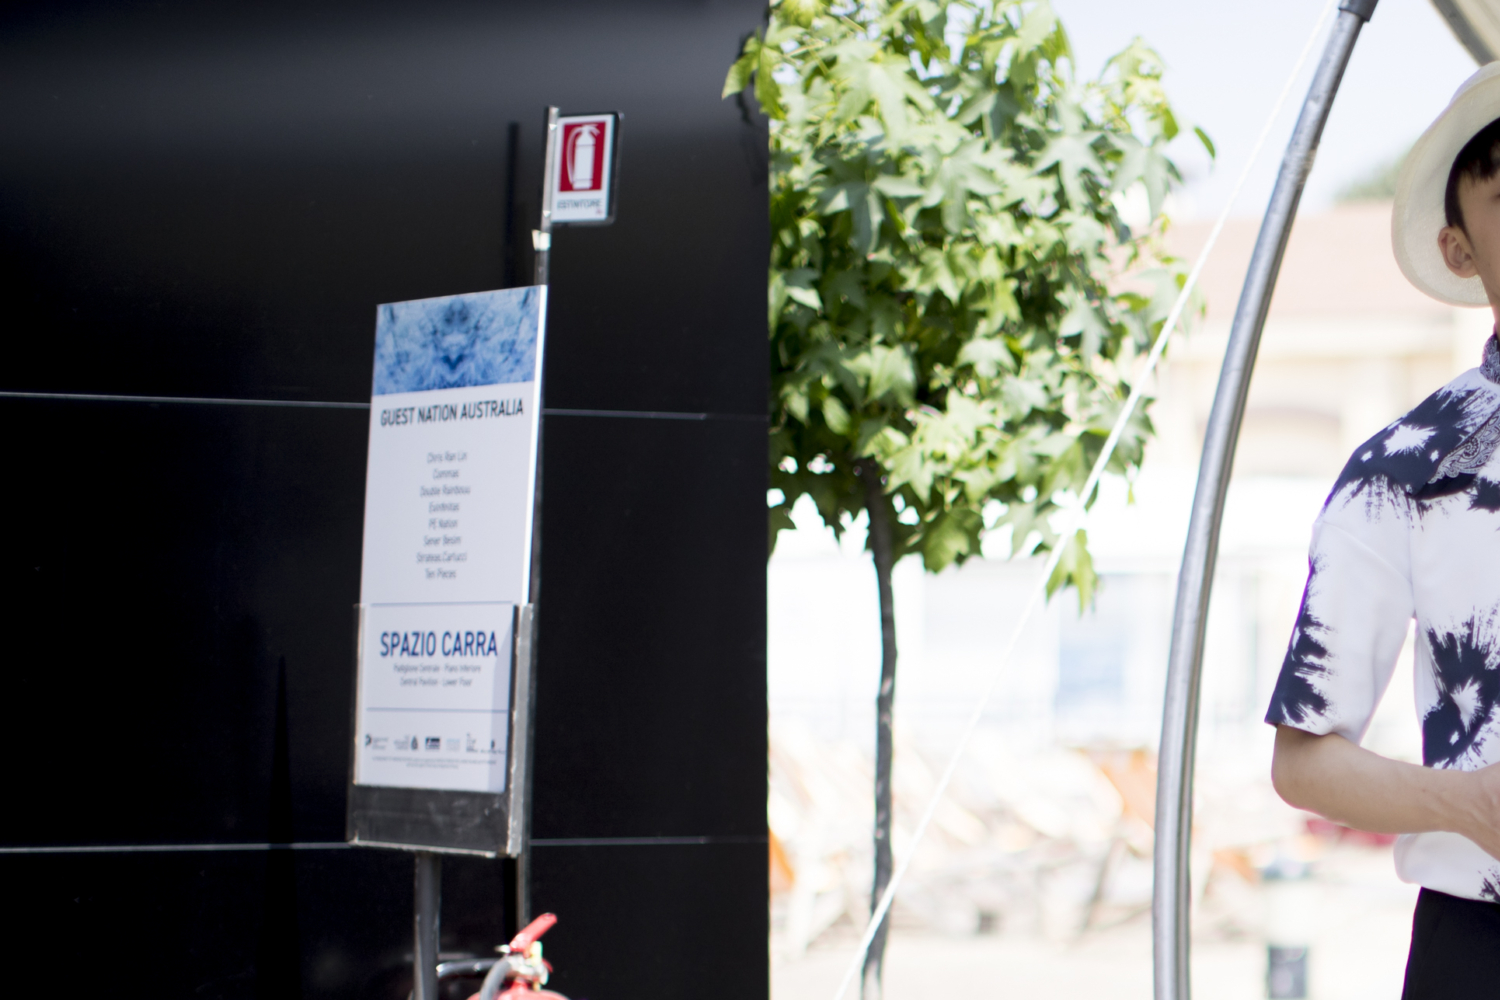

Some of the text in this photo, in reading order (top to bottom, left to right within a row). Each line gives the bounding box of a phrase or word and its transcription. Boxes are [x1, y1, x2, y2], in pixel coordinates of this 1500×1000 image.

[380, 398, 524, 427] GUEST NATION AUSTRALIA
[380, 630, 498, 657] SPAZIO CARRA
